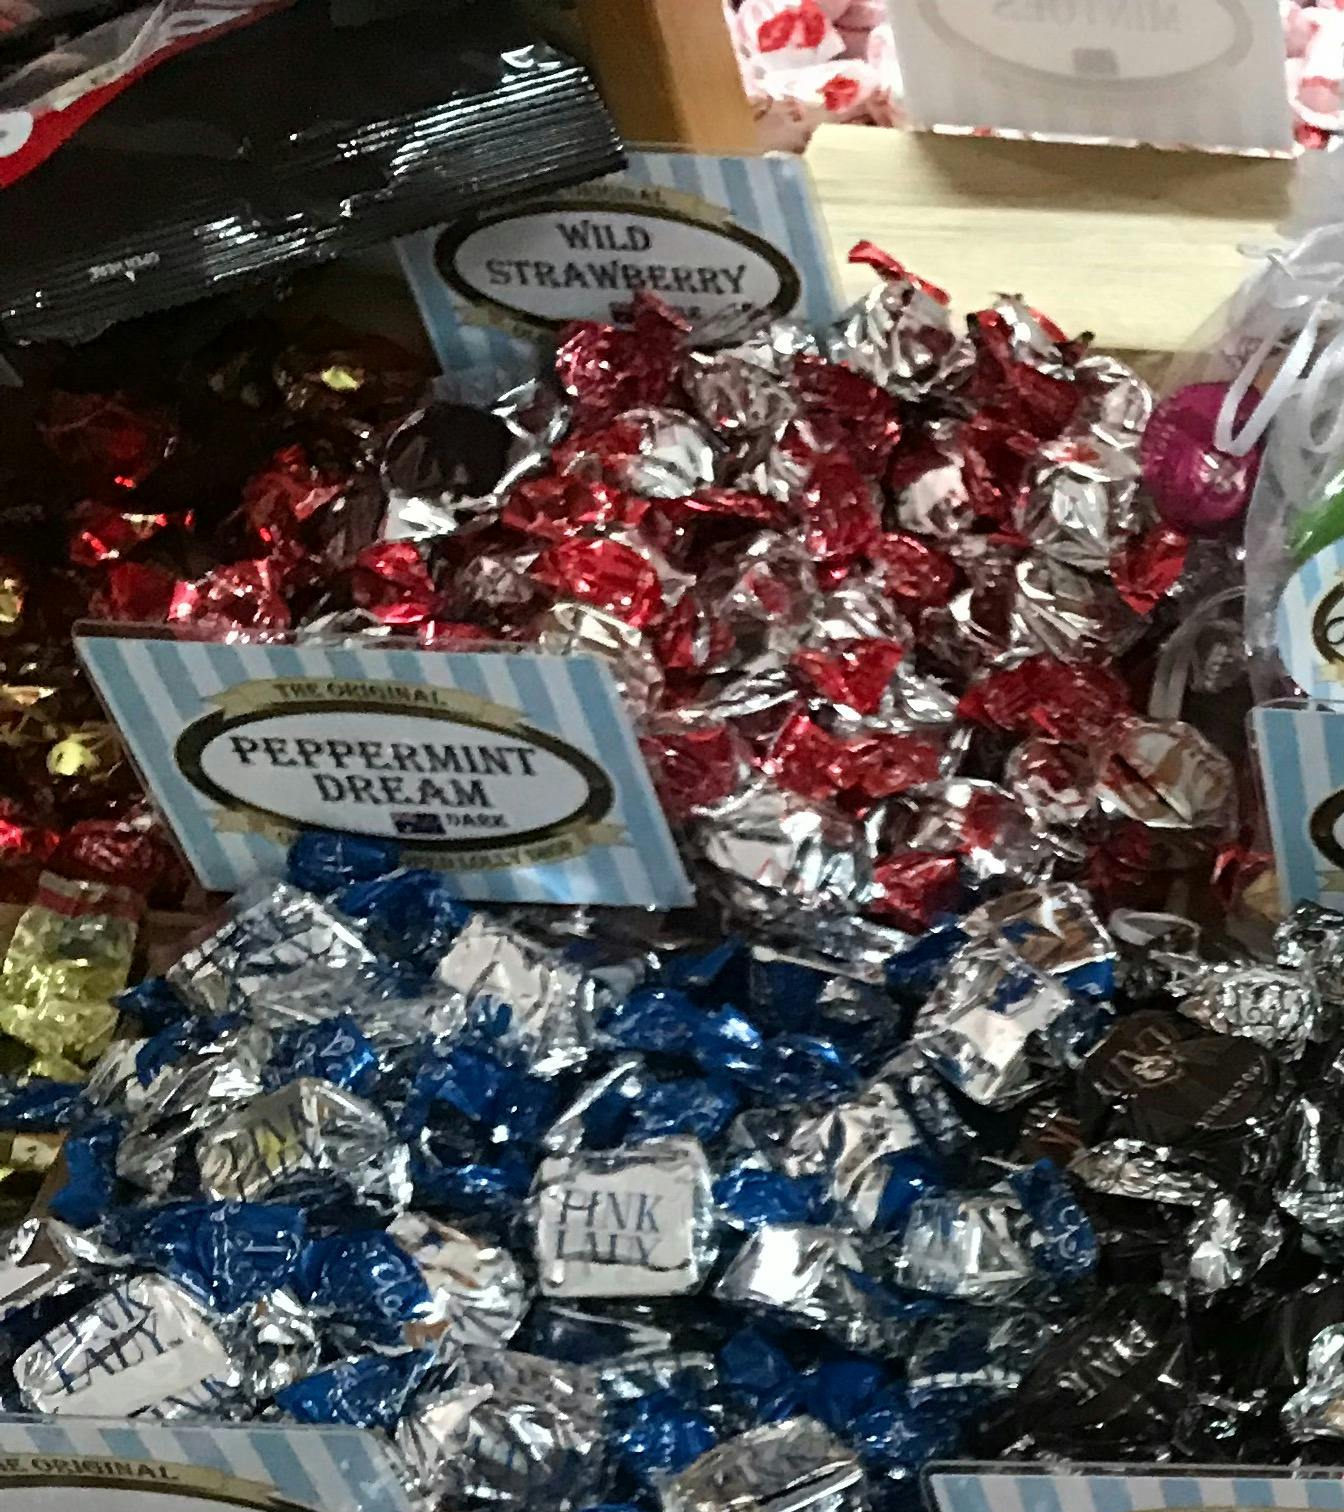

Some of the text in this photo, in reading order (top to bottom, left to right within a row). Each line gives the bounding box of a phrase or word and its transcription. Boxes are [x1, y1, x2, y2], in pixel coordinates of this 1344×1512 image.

[555, 220, 652, 252] WILD
[486, 258, 748, 295] STRAWBERRY
[231, 735, 537, 777] PEPPERMINT
[314, 774, 494, 808] DREAM
[31, 1458, 180, 1480] ORIGINAL
